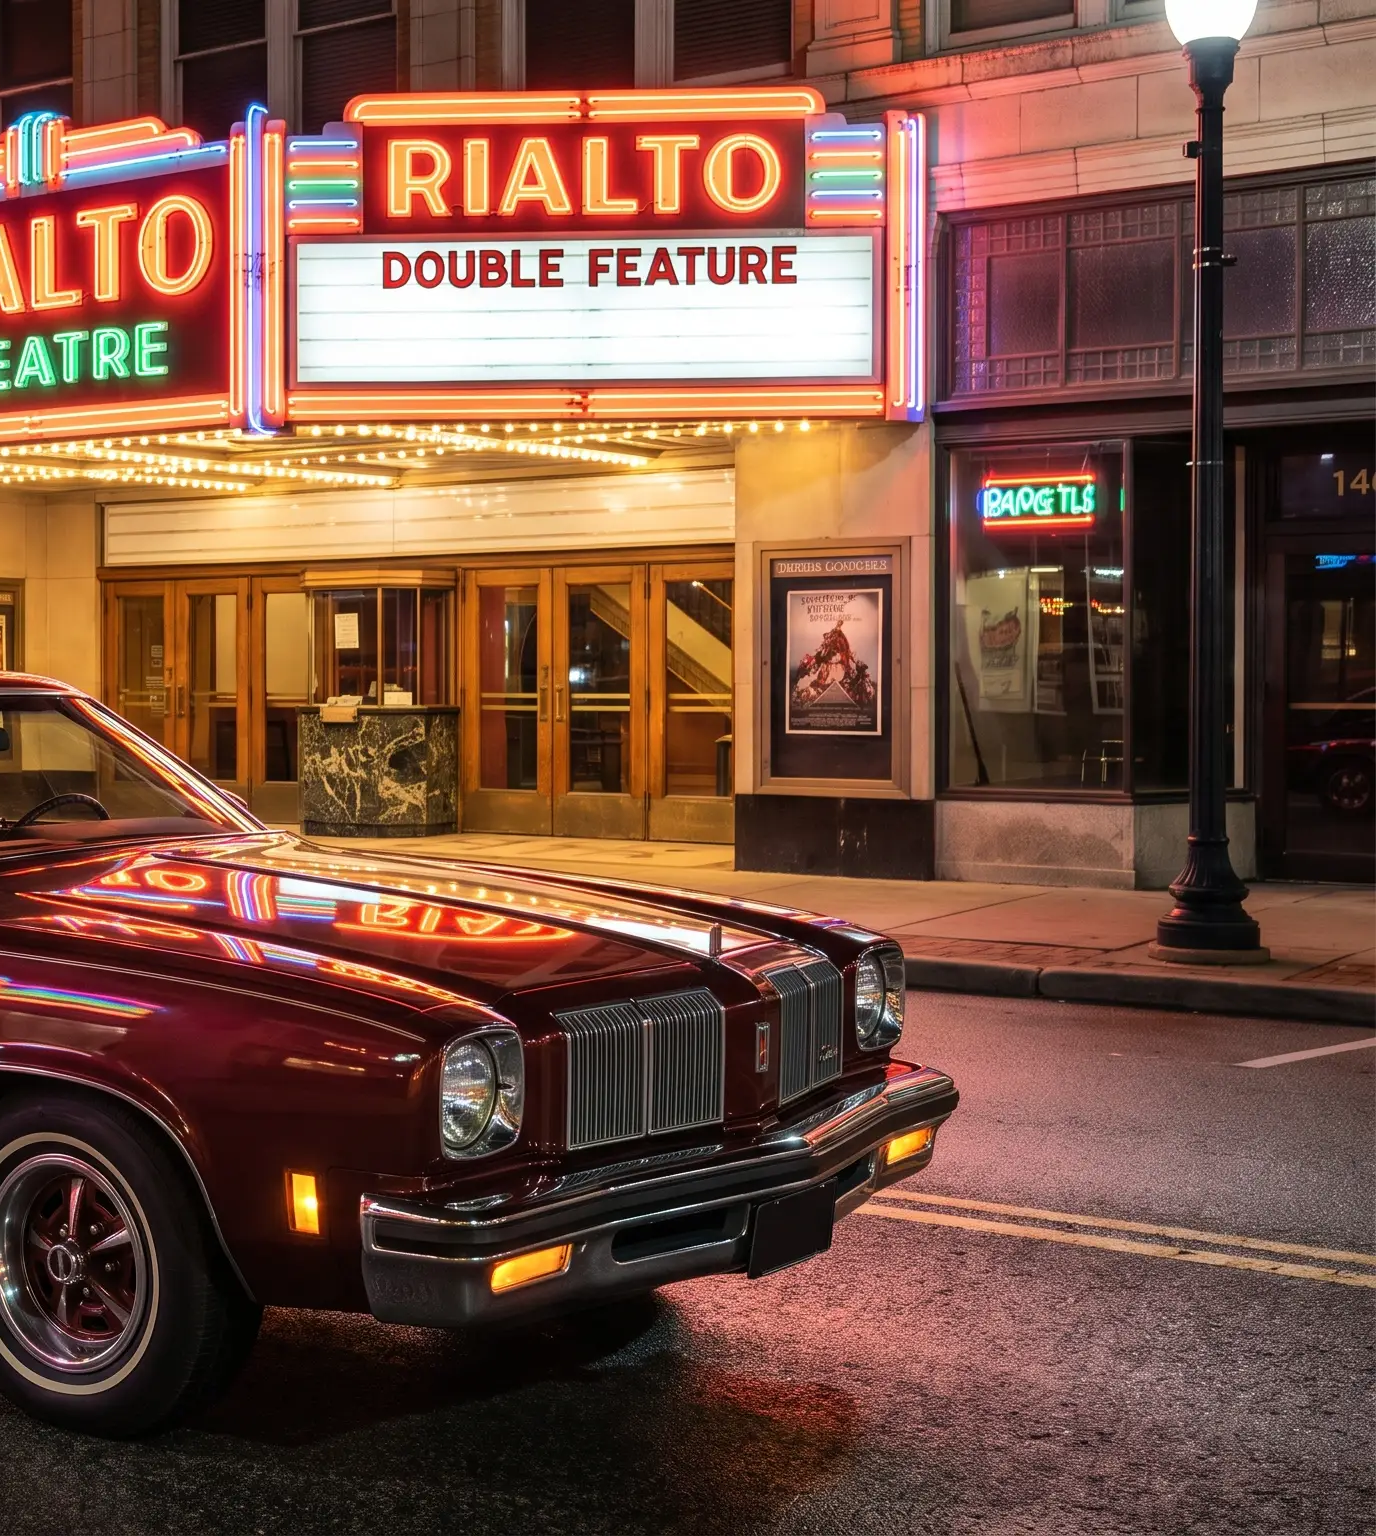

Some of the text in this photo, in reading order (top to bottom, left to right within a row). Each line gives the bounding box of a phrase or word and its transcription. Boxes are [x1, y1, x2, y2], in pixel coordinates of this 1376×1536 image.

[386, 132, 782, 218] RIALTO
[382, 245, 798, 289] DOUBLE FEATURE
[1333, 469, 1376, 496] 14
